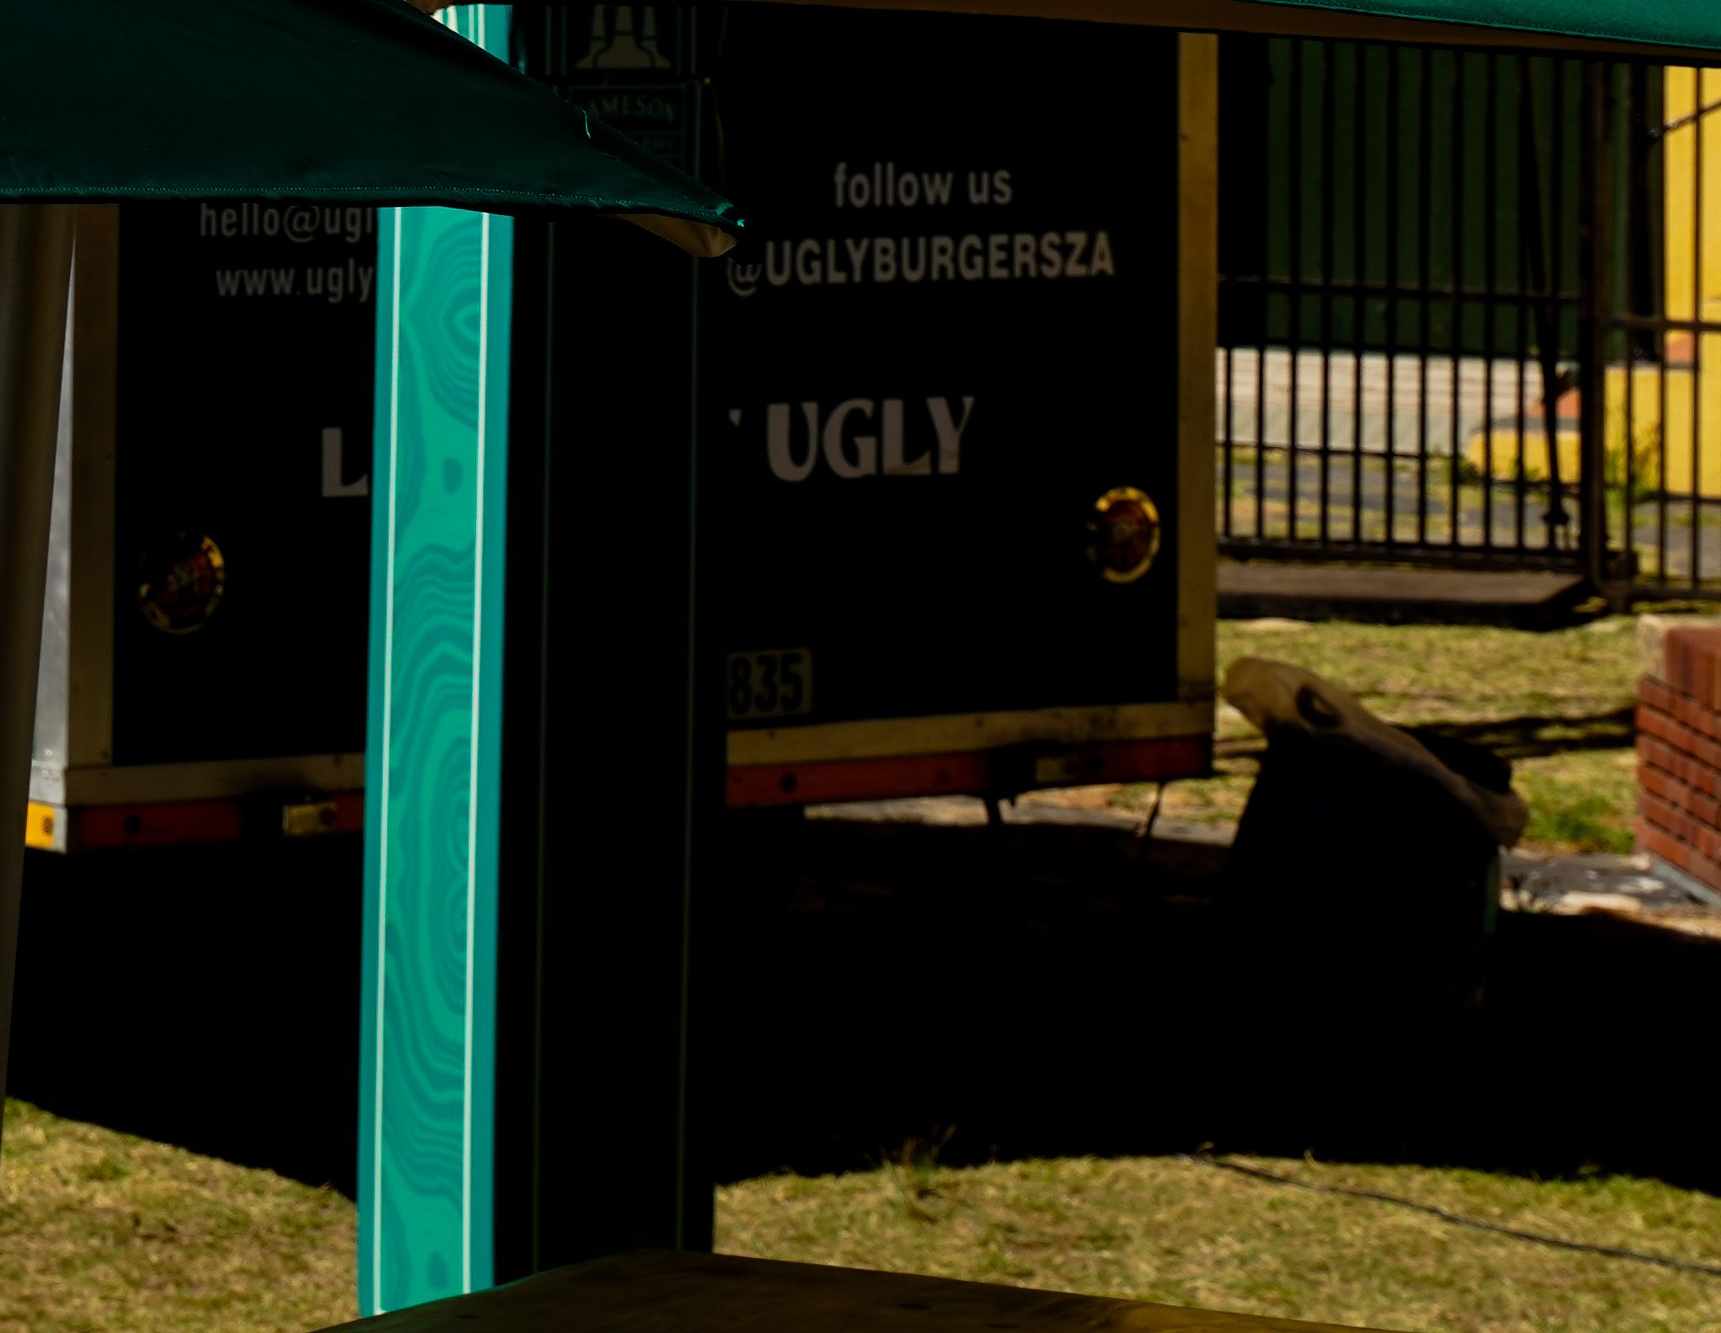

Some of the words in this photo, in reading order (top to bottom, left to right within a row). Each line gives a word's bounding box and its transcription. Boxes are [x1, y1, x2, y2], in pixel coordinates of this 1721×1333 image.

[583, 93, 677, 126] AMESON
[832, 159, 955, 209] follow
[966, 168, 1014, 207] us
[765, 394, 977, 484] UGLY
[729, 655, 802, 713] 835
